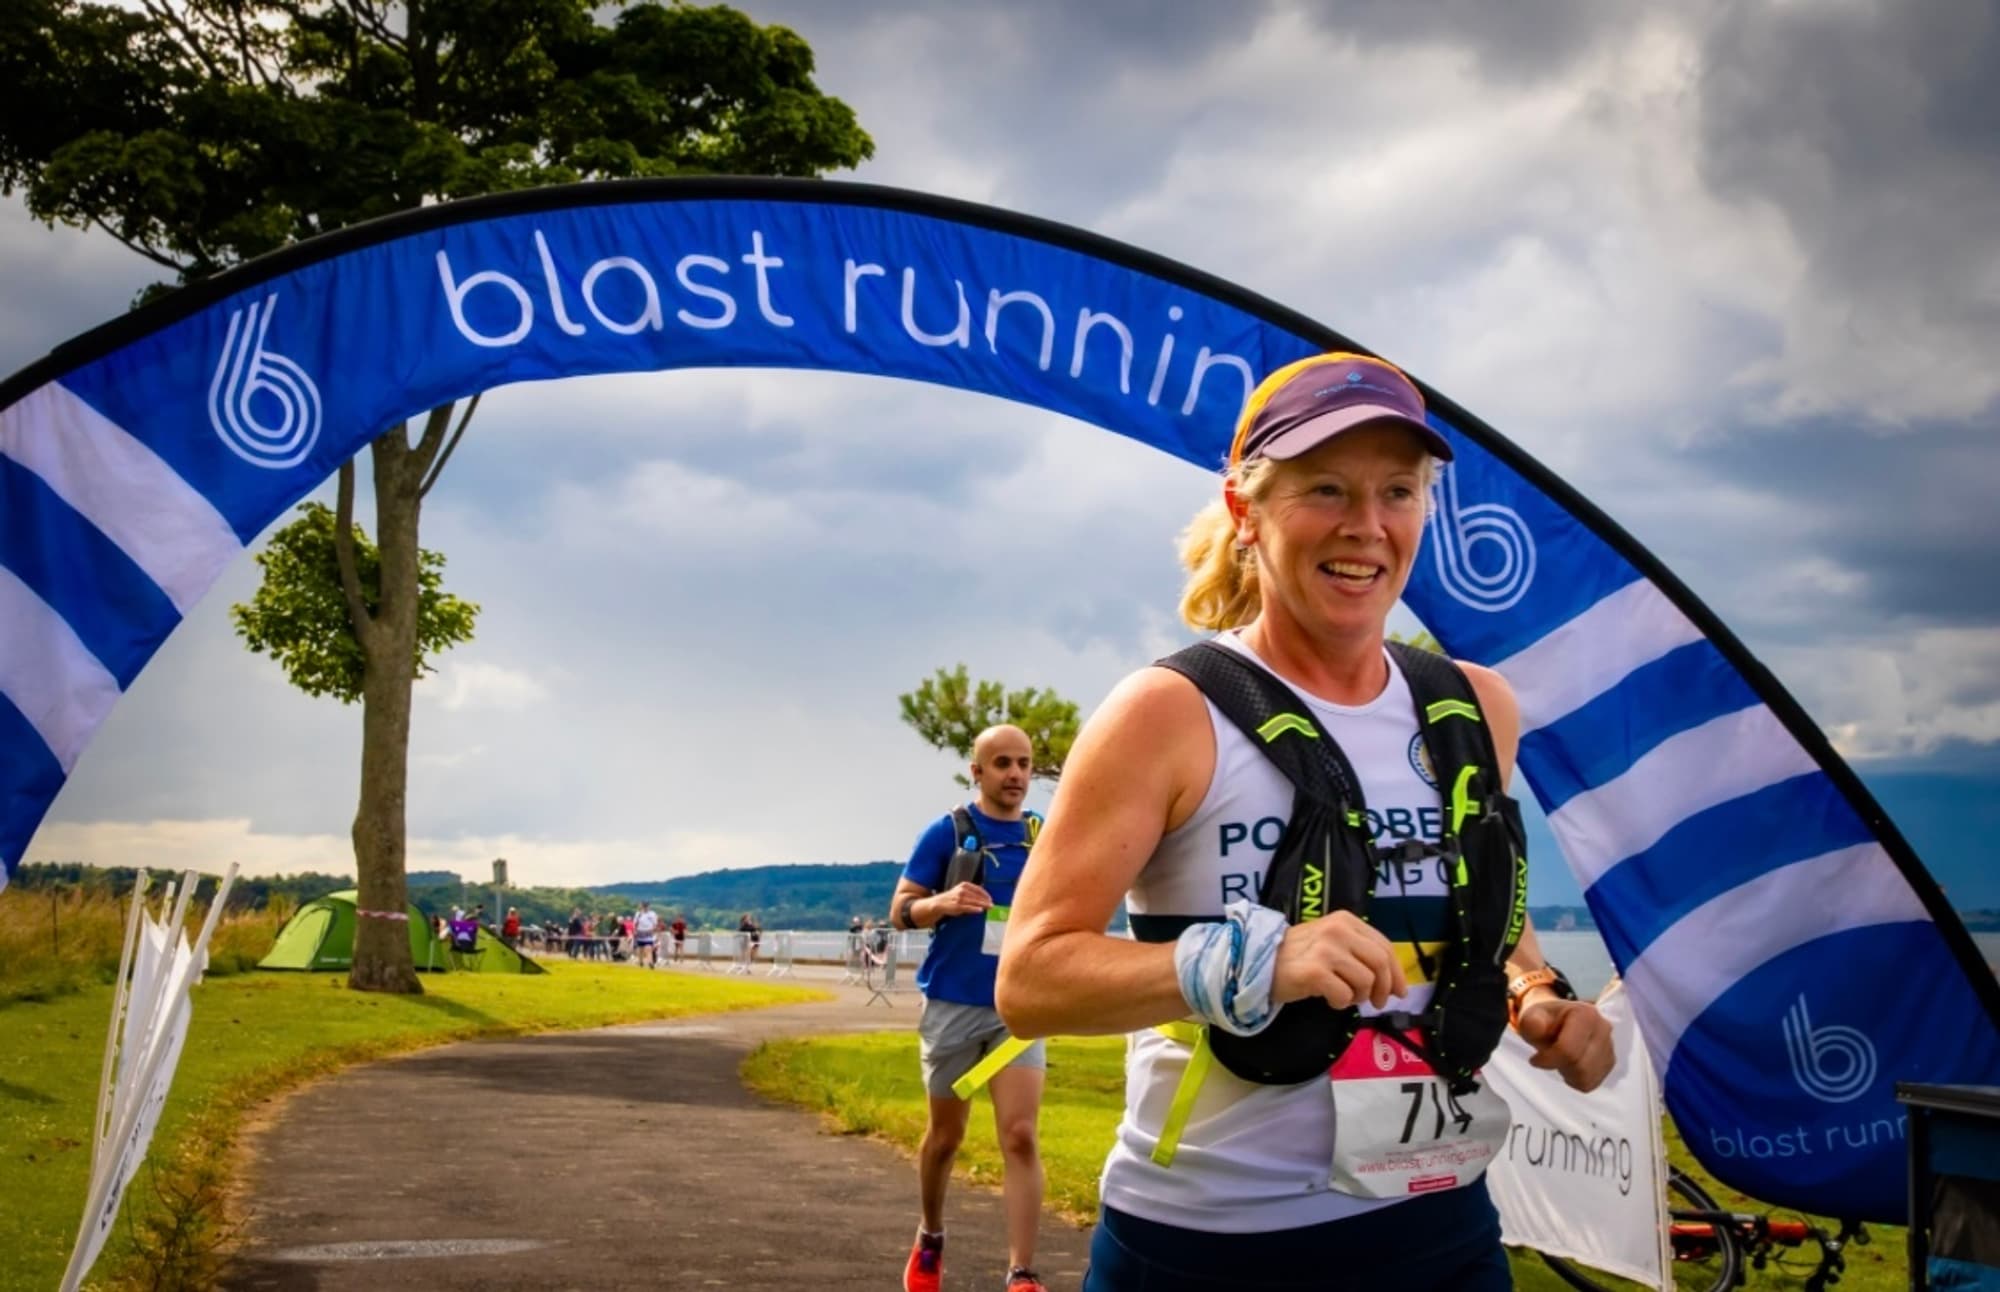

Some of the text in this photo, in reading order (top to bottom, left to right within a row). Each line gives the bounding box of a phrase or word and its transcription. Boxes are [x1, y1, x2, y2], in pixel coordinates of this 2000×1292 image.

[435, 229, 1256, 417] blast runnin
[1508, 1121, 1632, 1197] running
[1709, 1125, 1814, 1159] blast
